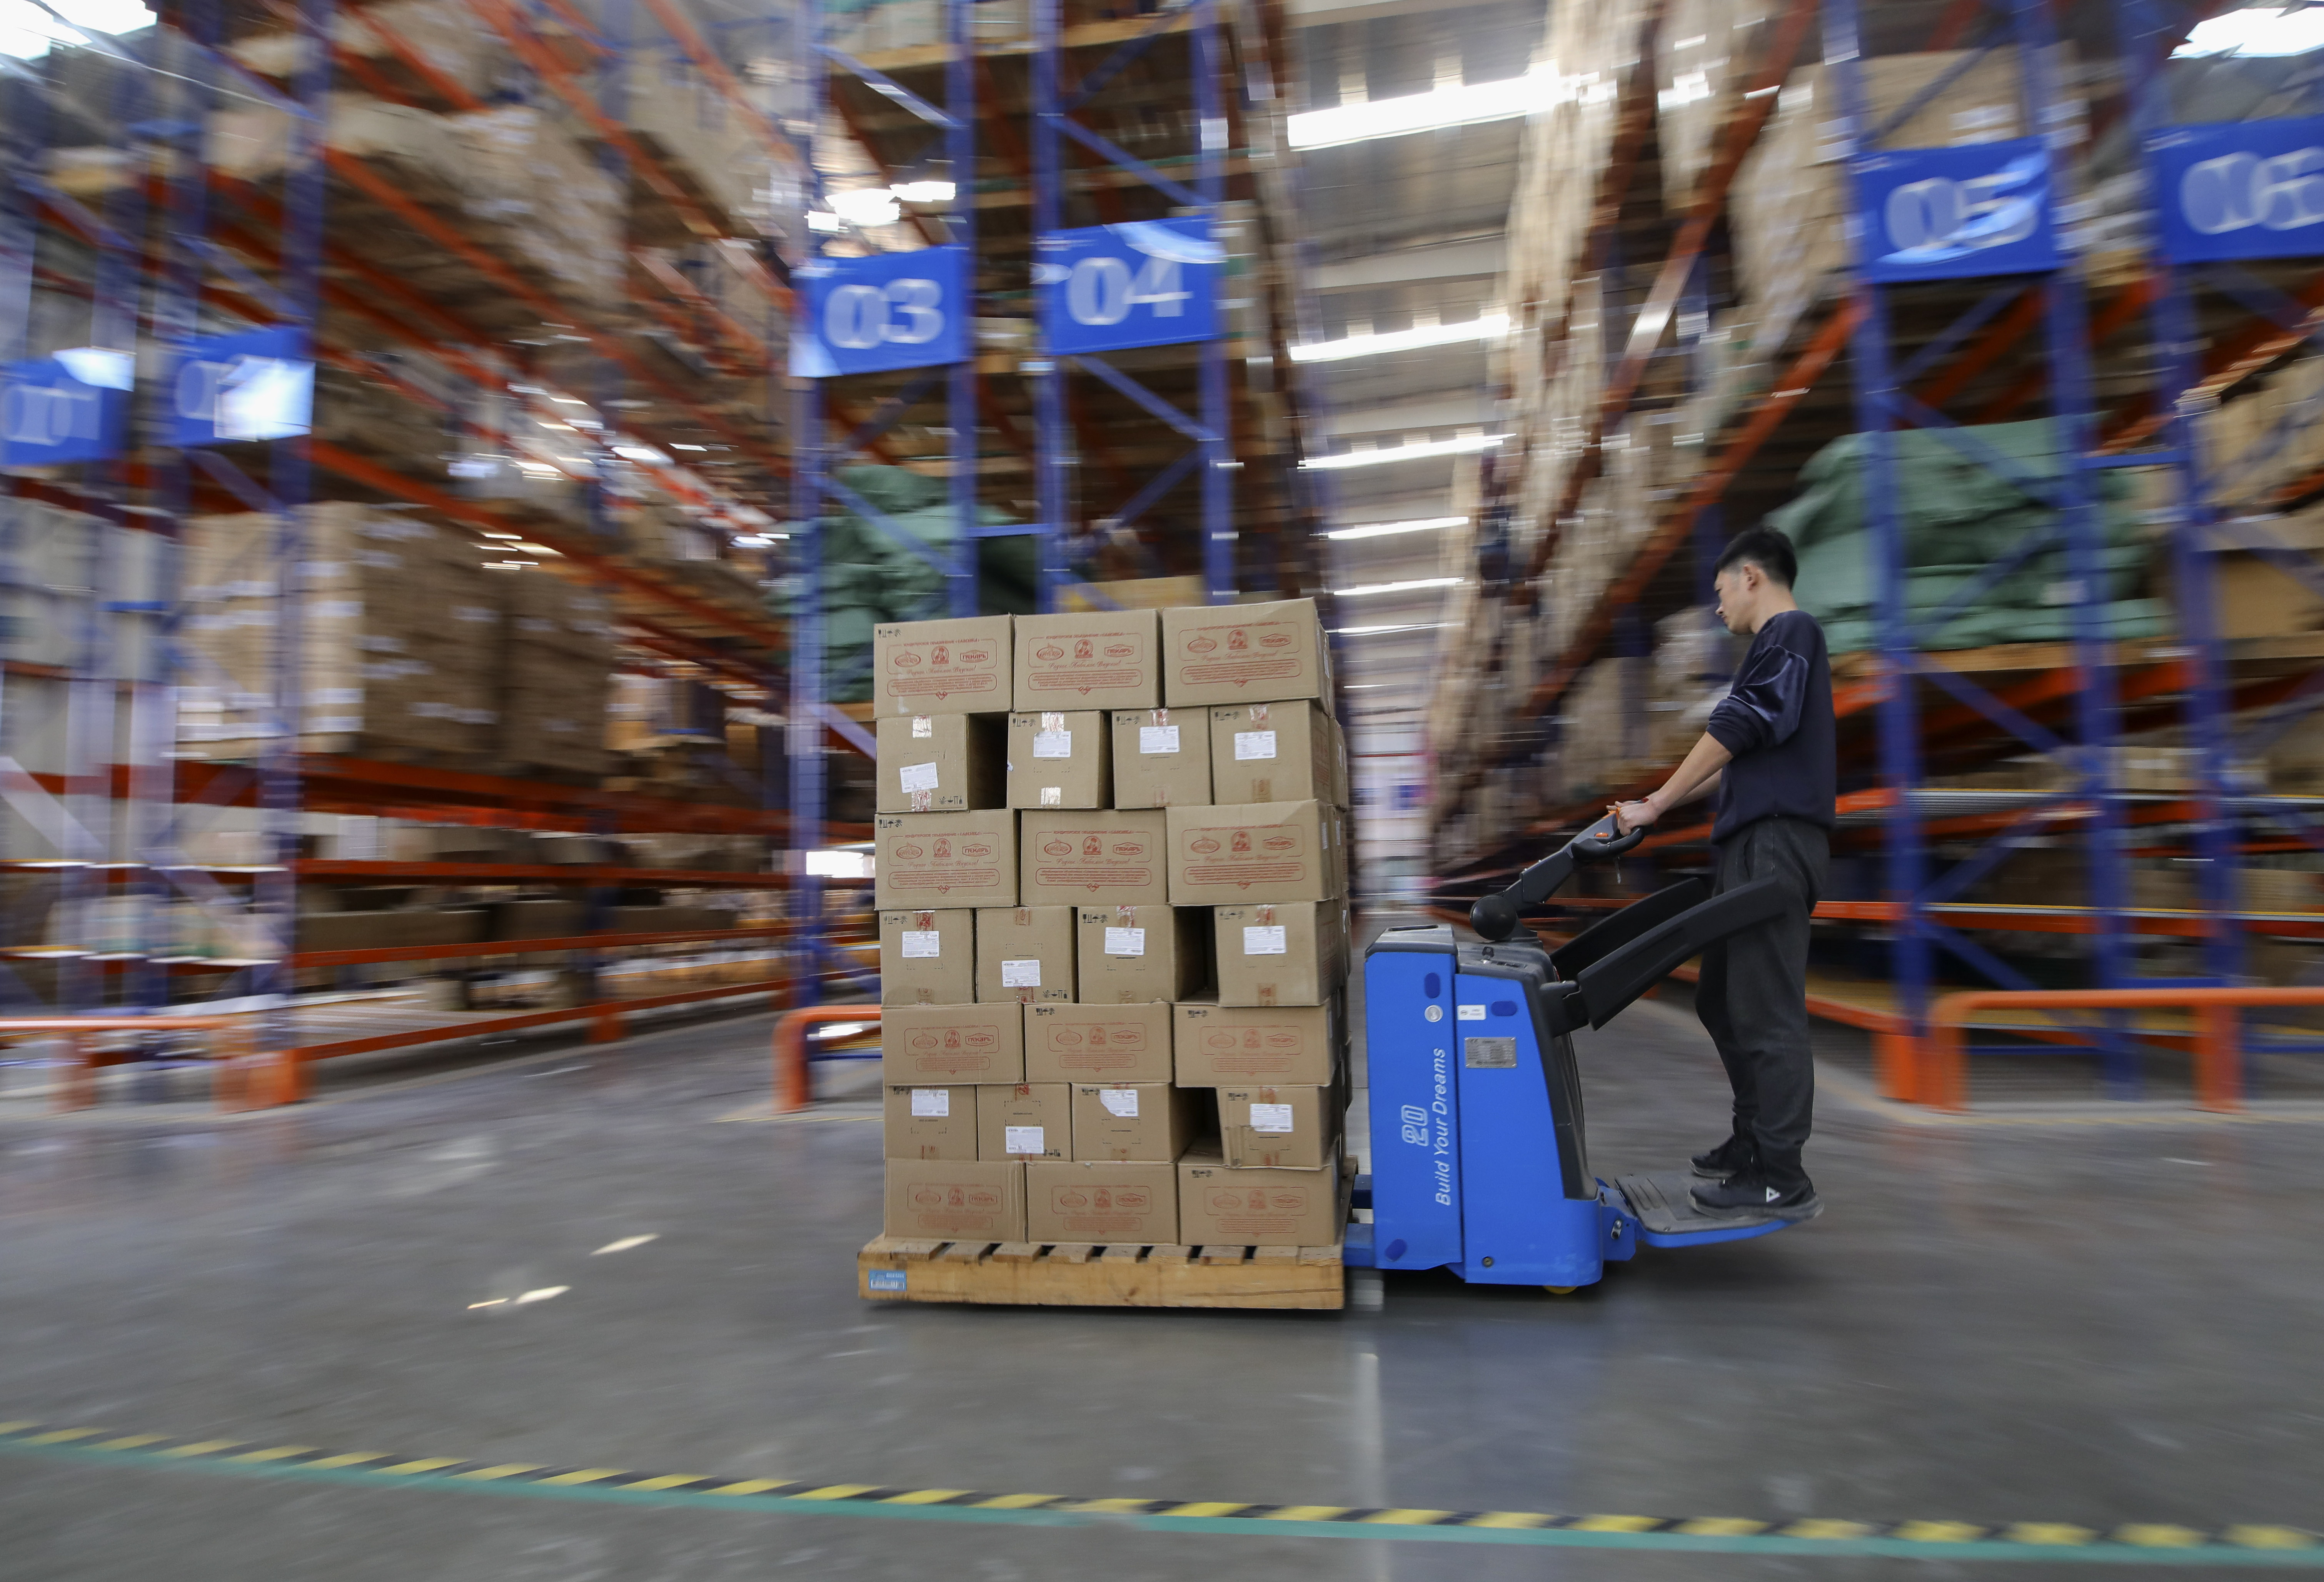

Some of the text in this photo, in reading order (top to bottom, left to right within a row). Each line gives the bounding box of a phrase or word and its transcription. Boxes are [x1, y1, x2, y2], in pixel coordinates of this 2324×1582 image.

[1885, 168, 2039, 250] 05
[823, 278, 945, 349] 03
[1066, 256, 1194, 325] 04
[1401, 1104, 1429, 1147] 20
[1432, 1048, 1451, 1206] Build Your Dreams
